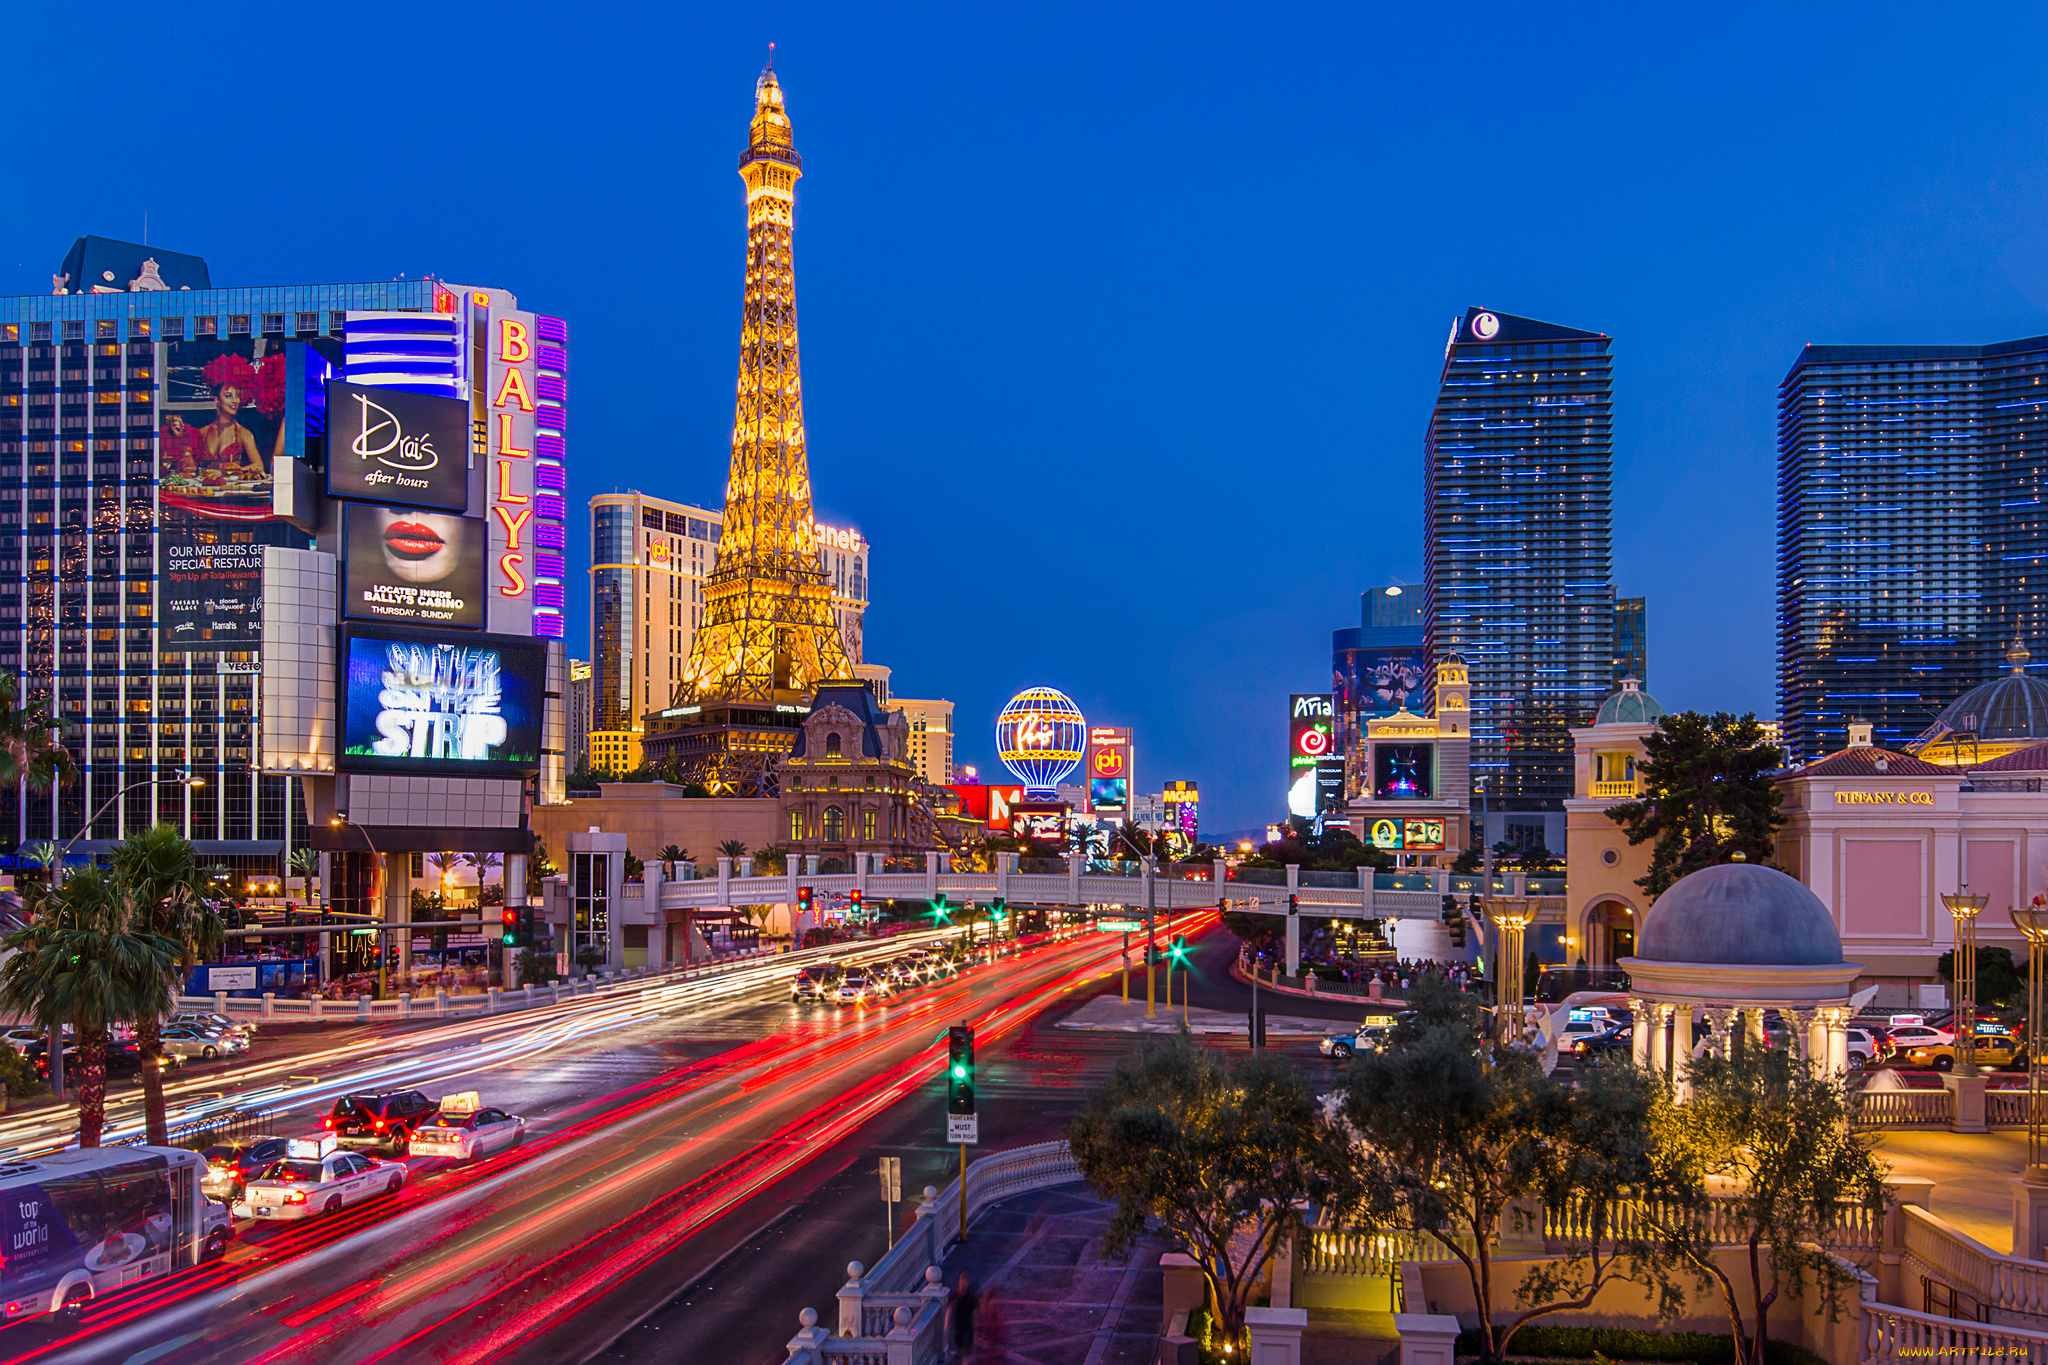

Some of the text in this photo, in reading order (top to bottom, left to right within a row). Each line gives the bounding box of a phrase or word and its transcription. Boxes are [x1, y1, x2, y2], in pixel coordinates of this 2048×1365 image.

[351, 393, 439, 470] Drai's
[493, 318, 535, 597] BALLYS
[364, 469, 429, 488] after hours
[169, 546, 193, 557] OUR
[195, 544, 247, 556] MEMBERS
[169, 557, 262, 570] SPECIAL RESTAUR
[169, 571, 187, 582] Sign
[187, 571, 199, 581] Up
[200, 572, 208, 580] at
[363, 590, 464, 609] BALLY'S CASINO
[373, 584, 452, 599] LOCATED INSIDE
[371, 605, 415, 617] THURSDAY
[420, 609, 453, 620] SUNDAY
[1294, 696, 1333, 718] Aria
[372, 709, 507, 760] STRIP
[1376, 726, 1436, 736] BELLAGIO
[1095, 748, 1122, 774] ph
[1162, 790, 1199, 803] MGM
[1834, 791, 1896, 804] TIFFANY
[1897, 791, 1908, 804] &
[19, 1201, 39, 1219] top
[24, 1221, 29, 1230] of
[13, 1223, 48, 1250] world
